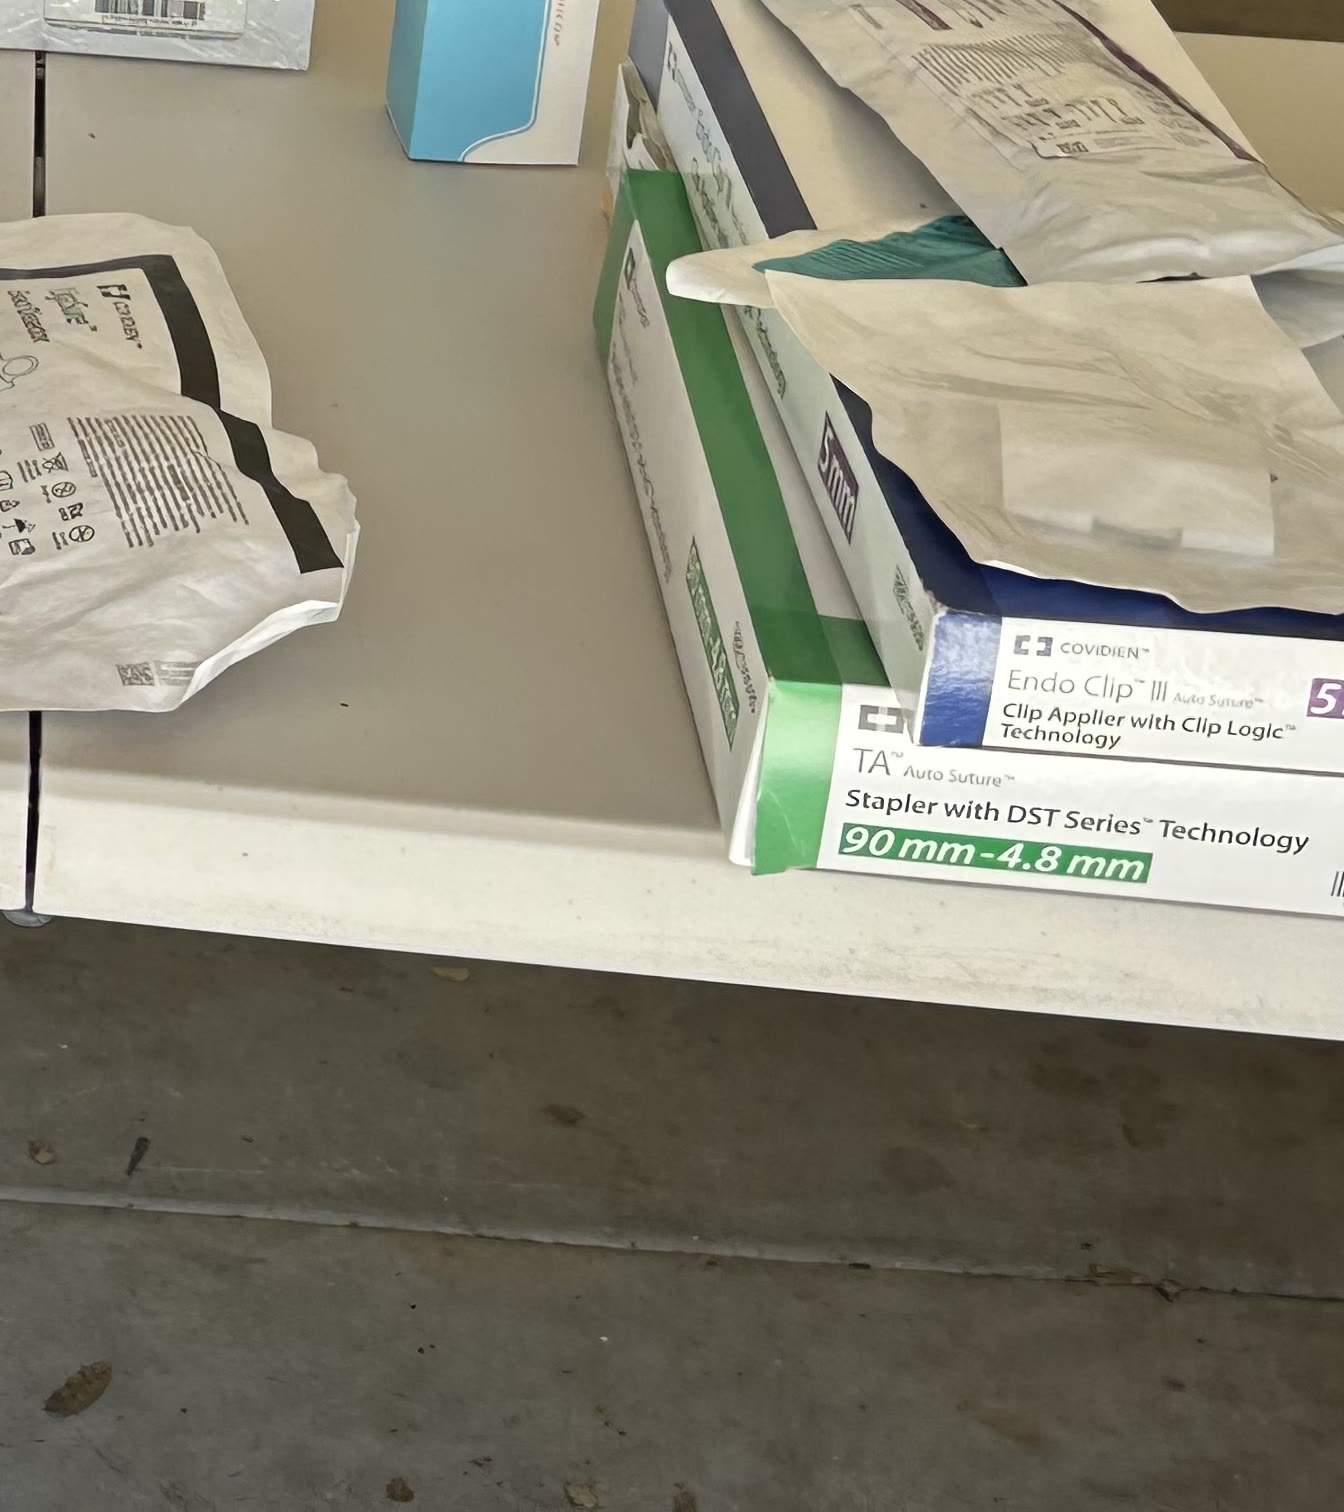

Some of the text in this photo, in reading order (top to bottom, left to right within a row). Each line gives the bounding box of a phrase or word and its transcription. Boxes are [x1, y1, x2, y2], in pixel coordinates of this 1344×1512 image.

[1007, 669, 1075, 696] Endo
[1150, 680, 1168, 703] III
[1173, 691, 1205, 706] Auto
[1310, 682, 1342, 715] 5
[1001, 723, 1122, 750] Technology
[1002, 702, 1043, 723] Clip
[1047, 706, 1126, 733] Applier
[1130, 712, 1176, 732] with
[1181, 717, 1222, 737] Clip
[903, 764, 944, 782] Auto
[846, 789, 939, 819] Stapler
[944, 798, 1001, 822] with
[1007, 805, 1060, 828] DST
[1159, 818, 1310, 856] Technology
[844, 827, 895, 856] 90
[1066, 855, 1146, 882] mm
